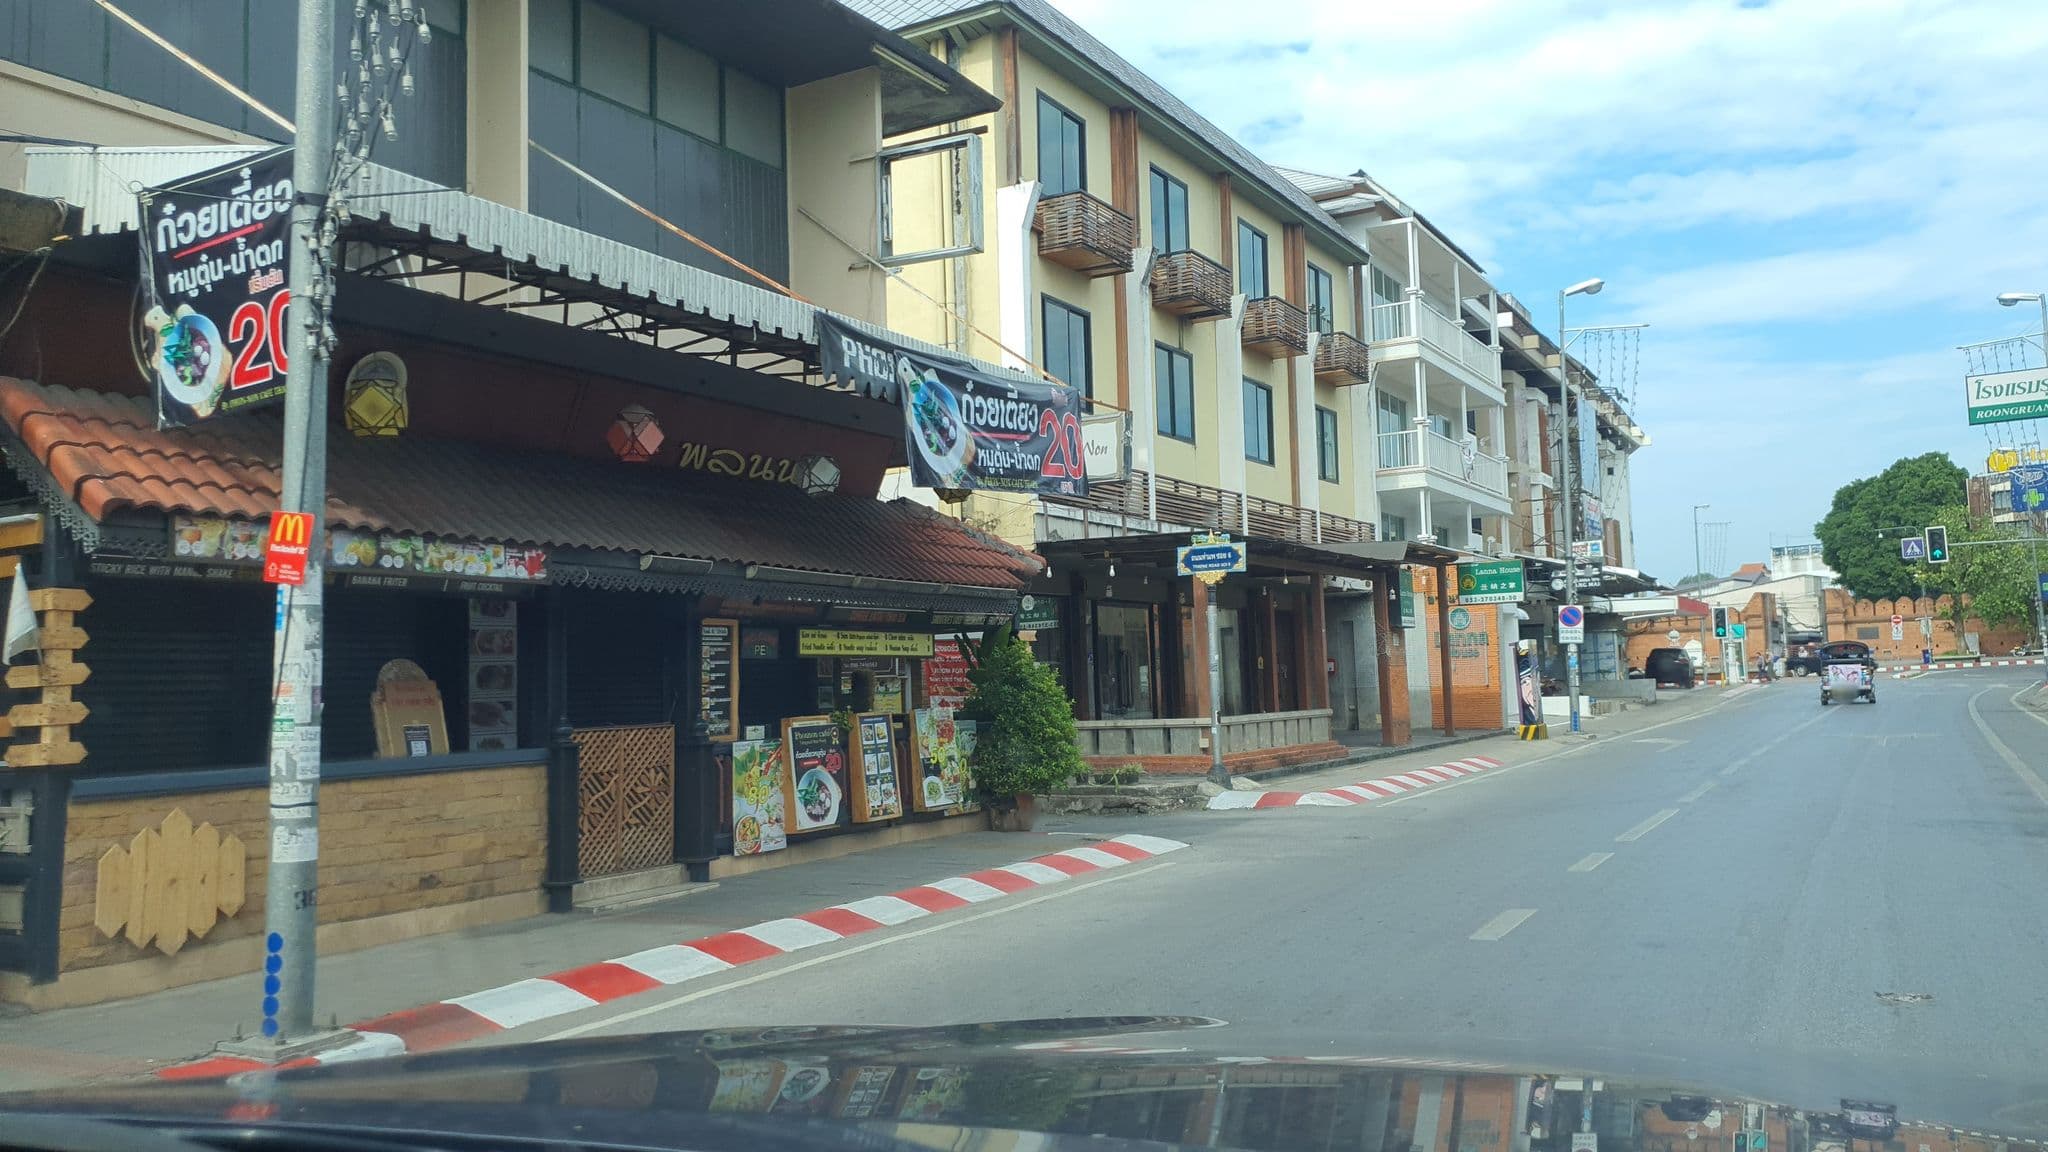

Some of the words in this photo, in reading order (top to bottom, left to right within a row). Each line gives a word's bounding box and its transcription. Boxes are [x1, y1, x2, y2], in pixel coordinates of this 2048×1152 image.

[1038, 407, 1084, 480] 20
[1499, 566, 1521, 574] House
[826, 752, 842, 772] 20
[748, 784, 770, 807] 80
